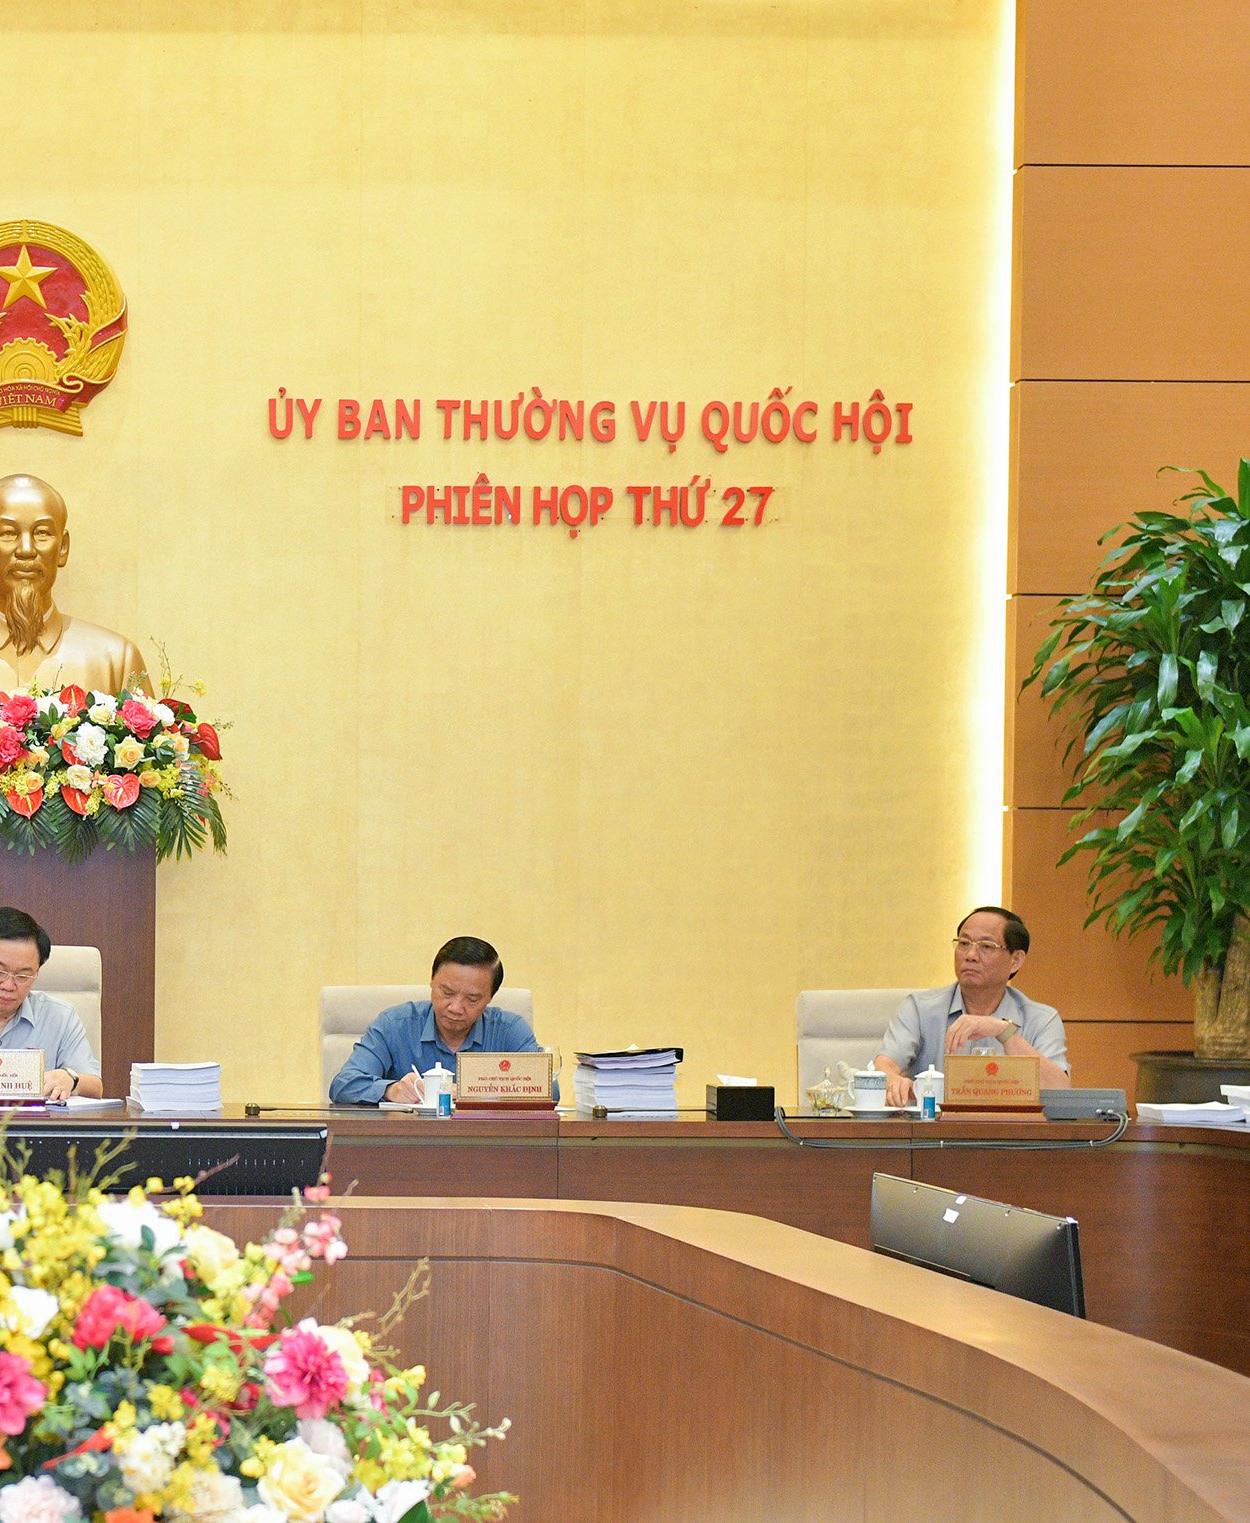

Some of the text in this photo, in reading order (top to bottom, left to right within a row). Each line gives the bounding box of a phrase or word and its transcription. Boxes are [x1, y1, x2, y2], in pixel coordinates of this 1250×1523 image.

[25, 394, 57, 407] NAM
[268, 386, 914, 454] ỦY BAN THƯỜNG VỤ QUỐC HỘI
[402, 472, 775, 538] PHIÊN HỌP THỨ 27
